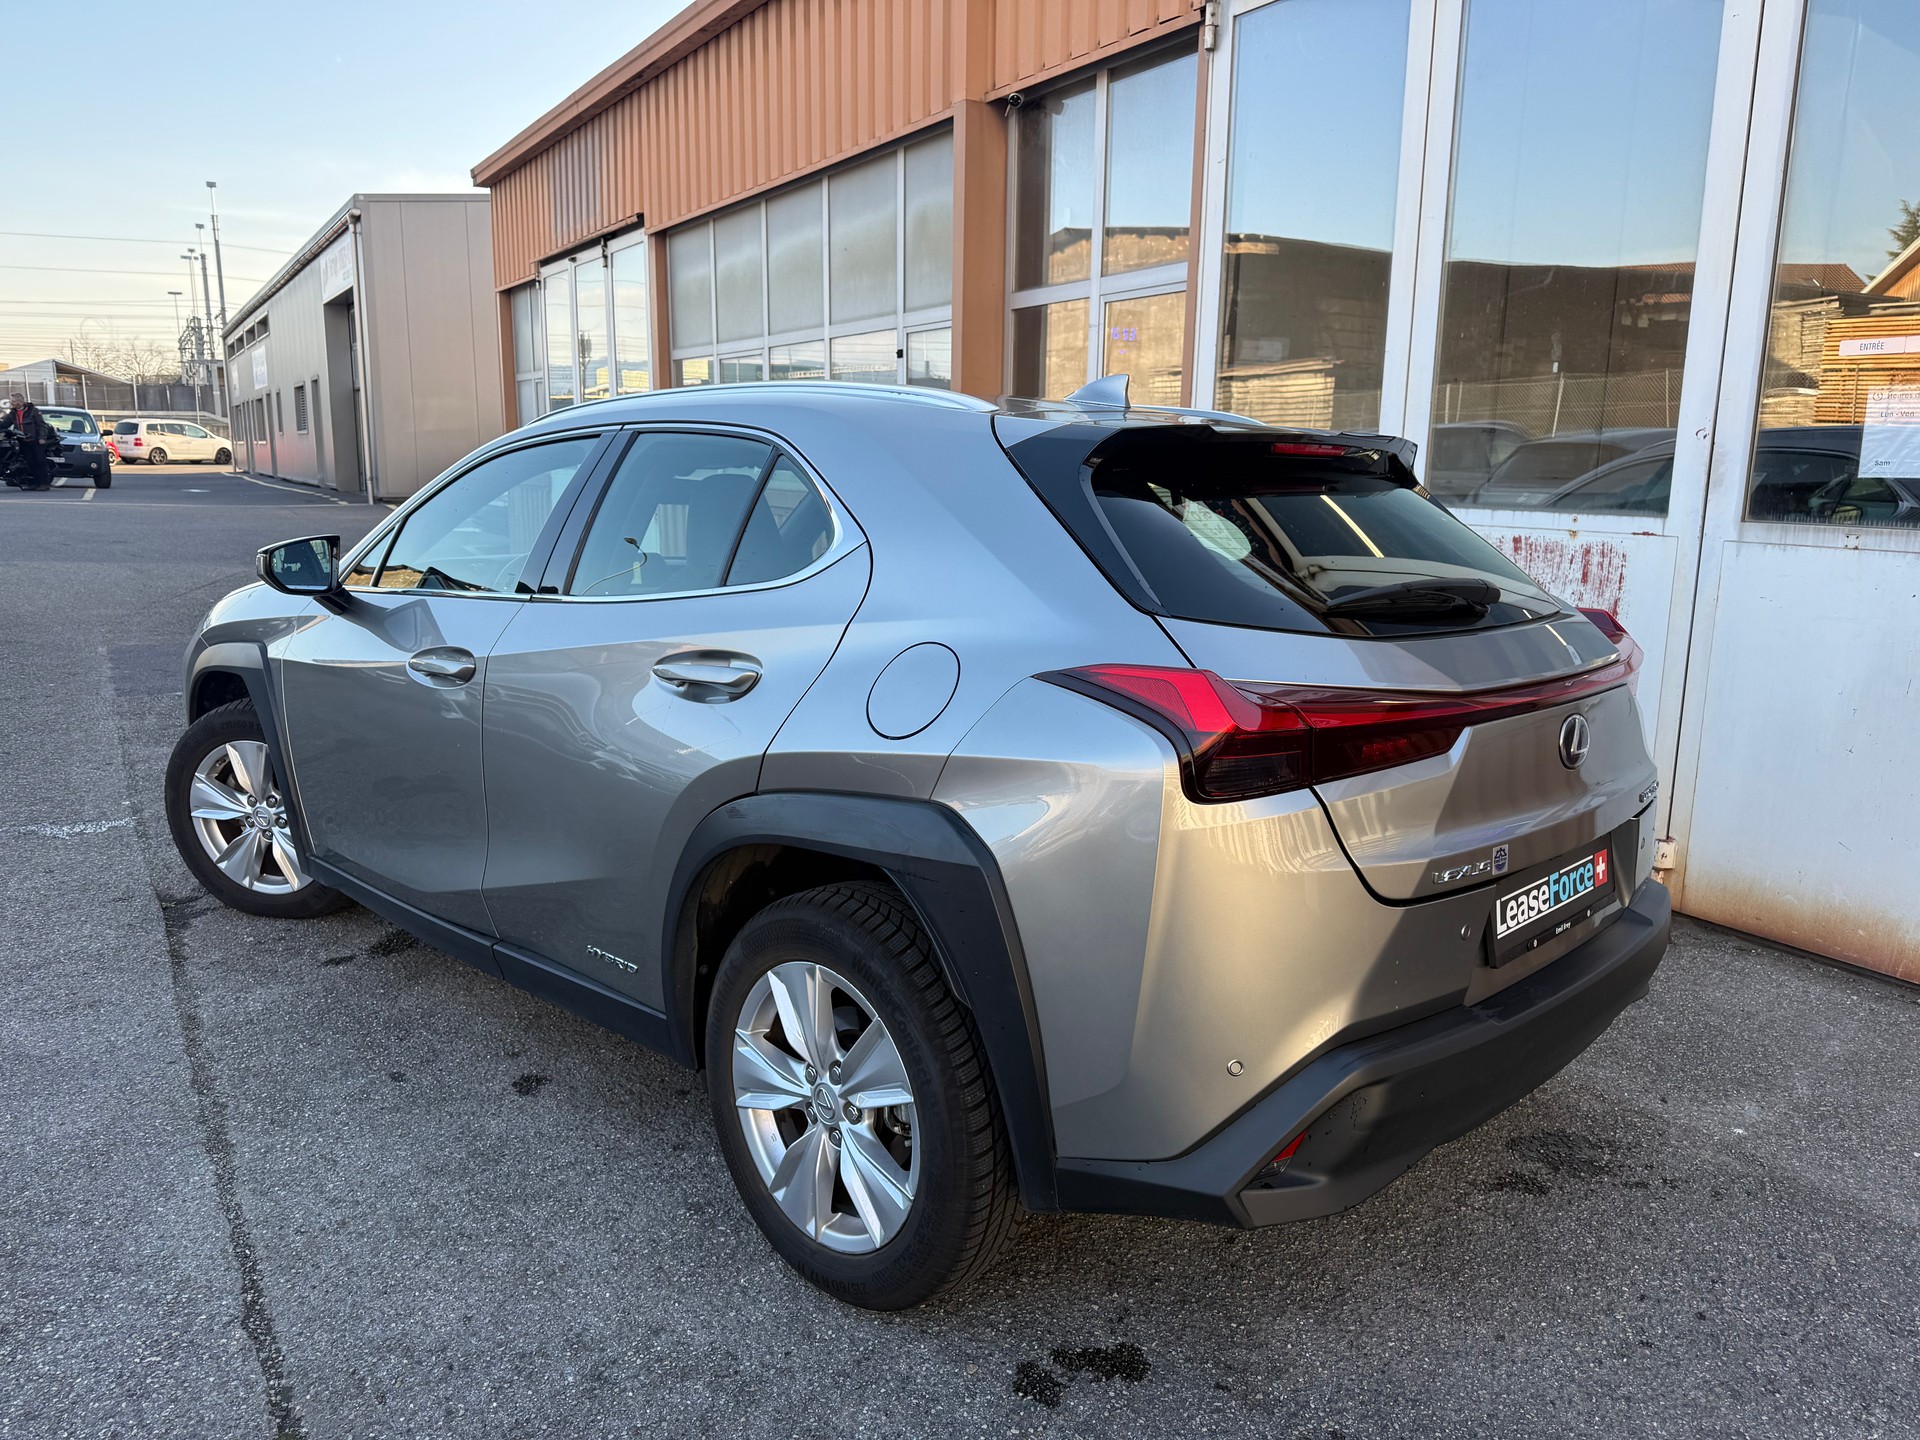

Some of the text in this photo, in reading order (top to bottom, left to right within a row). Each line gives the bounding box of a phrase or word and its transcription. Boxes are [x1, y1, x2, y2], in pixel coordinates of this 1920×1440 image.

[1859, 340, 1885, 351] ENTRÉE
[1874, 459, 1891, 467] Sam
[1432, 860, 1491, 884] LEXUS
[1496, 862, 1594, 935] LeaseForce
